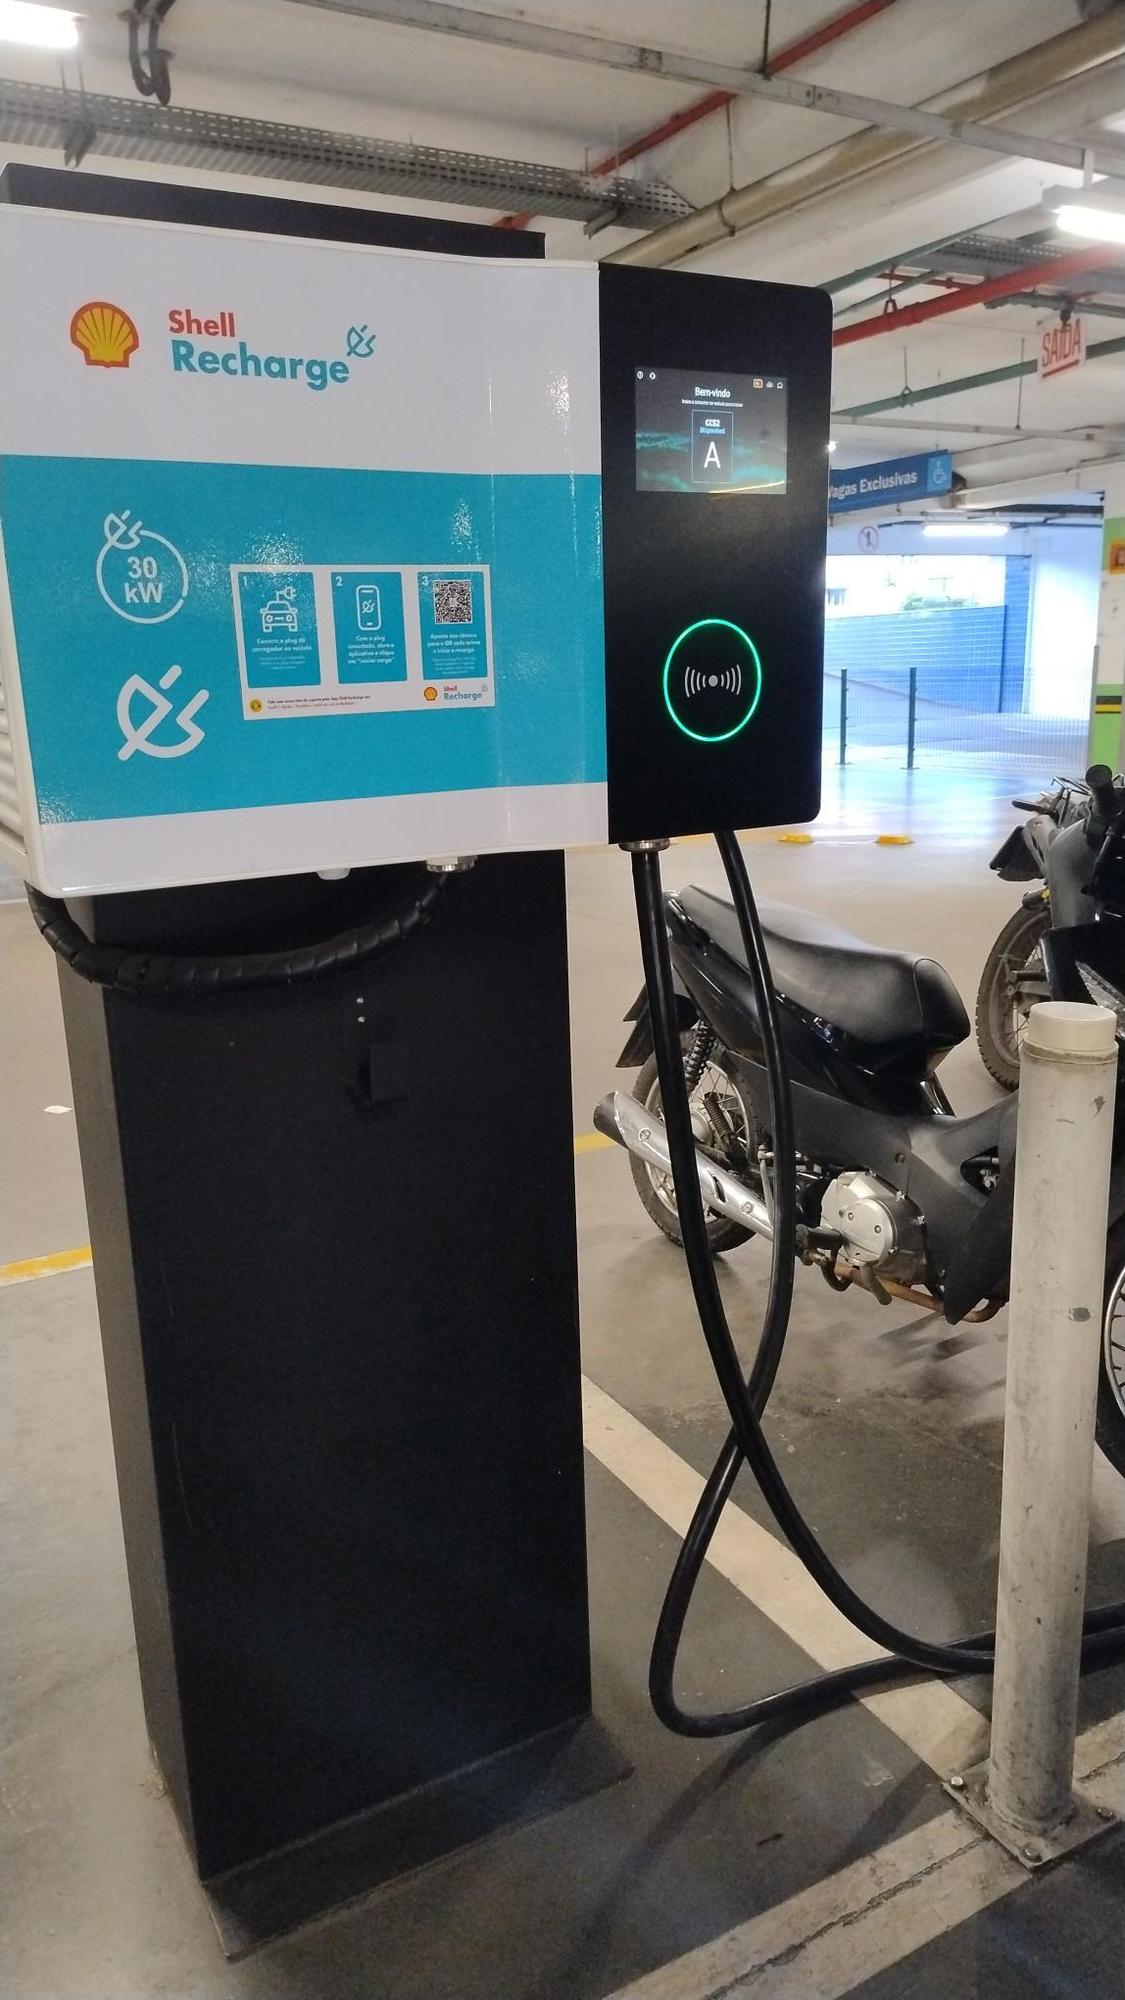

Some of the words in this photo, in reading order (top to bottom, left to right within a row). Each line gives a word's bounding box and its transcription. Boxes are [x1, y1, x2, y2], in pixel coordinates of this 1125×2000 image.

[168, 308, 237, 338] Shell
[171, 339, 350, 391] Recharge
[694, 386, 731, 399] Bem-vindo
[704, 418, 721, 427] CCS2
[703, 440, 721, 469] A
[859, 471, 918, 493] Exclusivas
[127, 556, 158, 579] 30
[243, 575, 248, 587] 1
[335, 576, 343, 587] 2
[422, 575, 429, 586] 3
[124, 582, 163, 604] kW
[443, 691, 482, 701] Recharge
